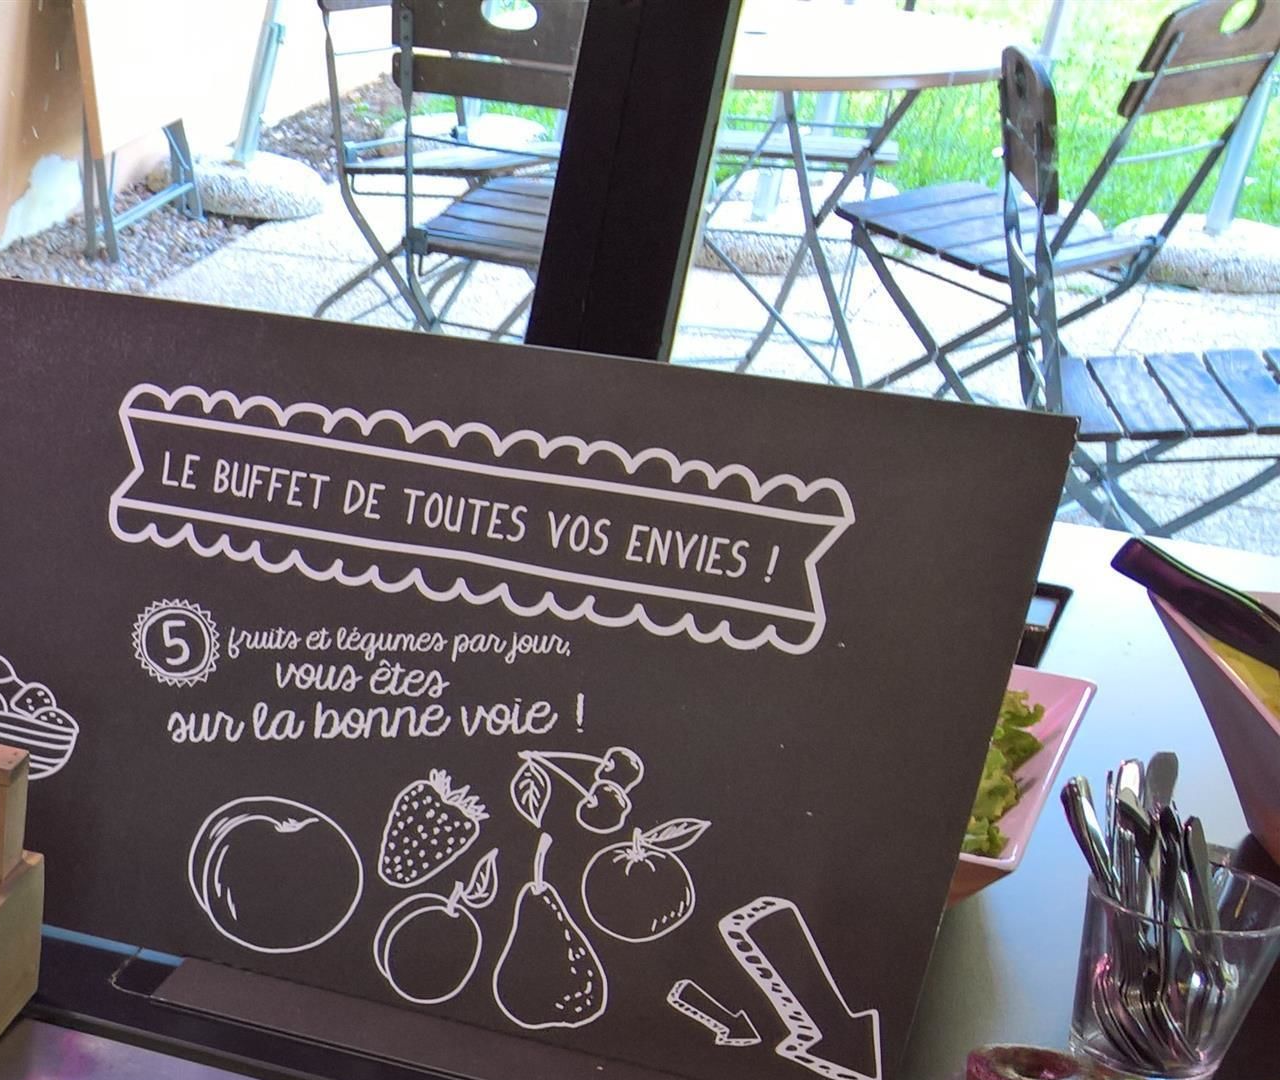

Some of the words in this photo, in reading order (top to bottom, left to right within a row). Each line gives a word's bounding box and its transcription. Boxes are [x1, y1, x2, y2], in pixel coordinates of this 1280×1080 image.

[162, 451, 200, 490] LE
[213, 459, 331, 510] BUFFET
[343, 479, 386, 520] DE
[403, 488, 528, 543] TOUTES
[547, 510, 611, 556] VOS
[625, 524, 751, 579] ENVIES
[162, 619, 191, 666] 5
[227, 626, 301, 659] fruits
[305, 627, 333, 651] et
[336, 626, 448, 662] légumes
[451, 631, 507, 662] par
[275, 661, 363, 692] vous
[369, 659, 451, 698] êtes
[167, 711, 245, 743] sur
[252, 701, 305, 741] la
[314, 701, 452, 739] bonne
[461, 698, 558, 737] voie
